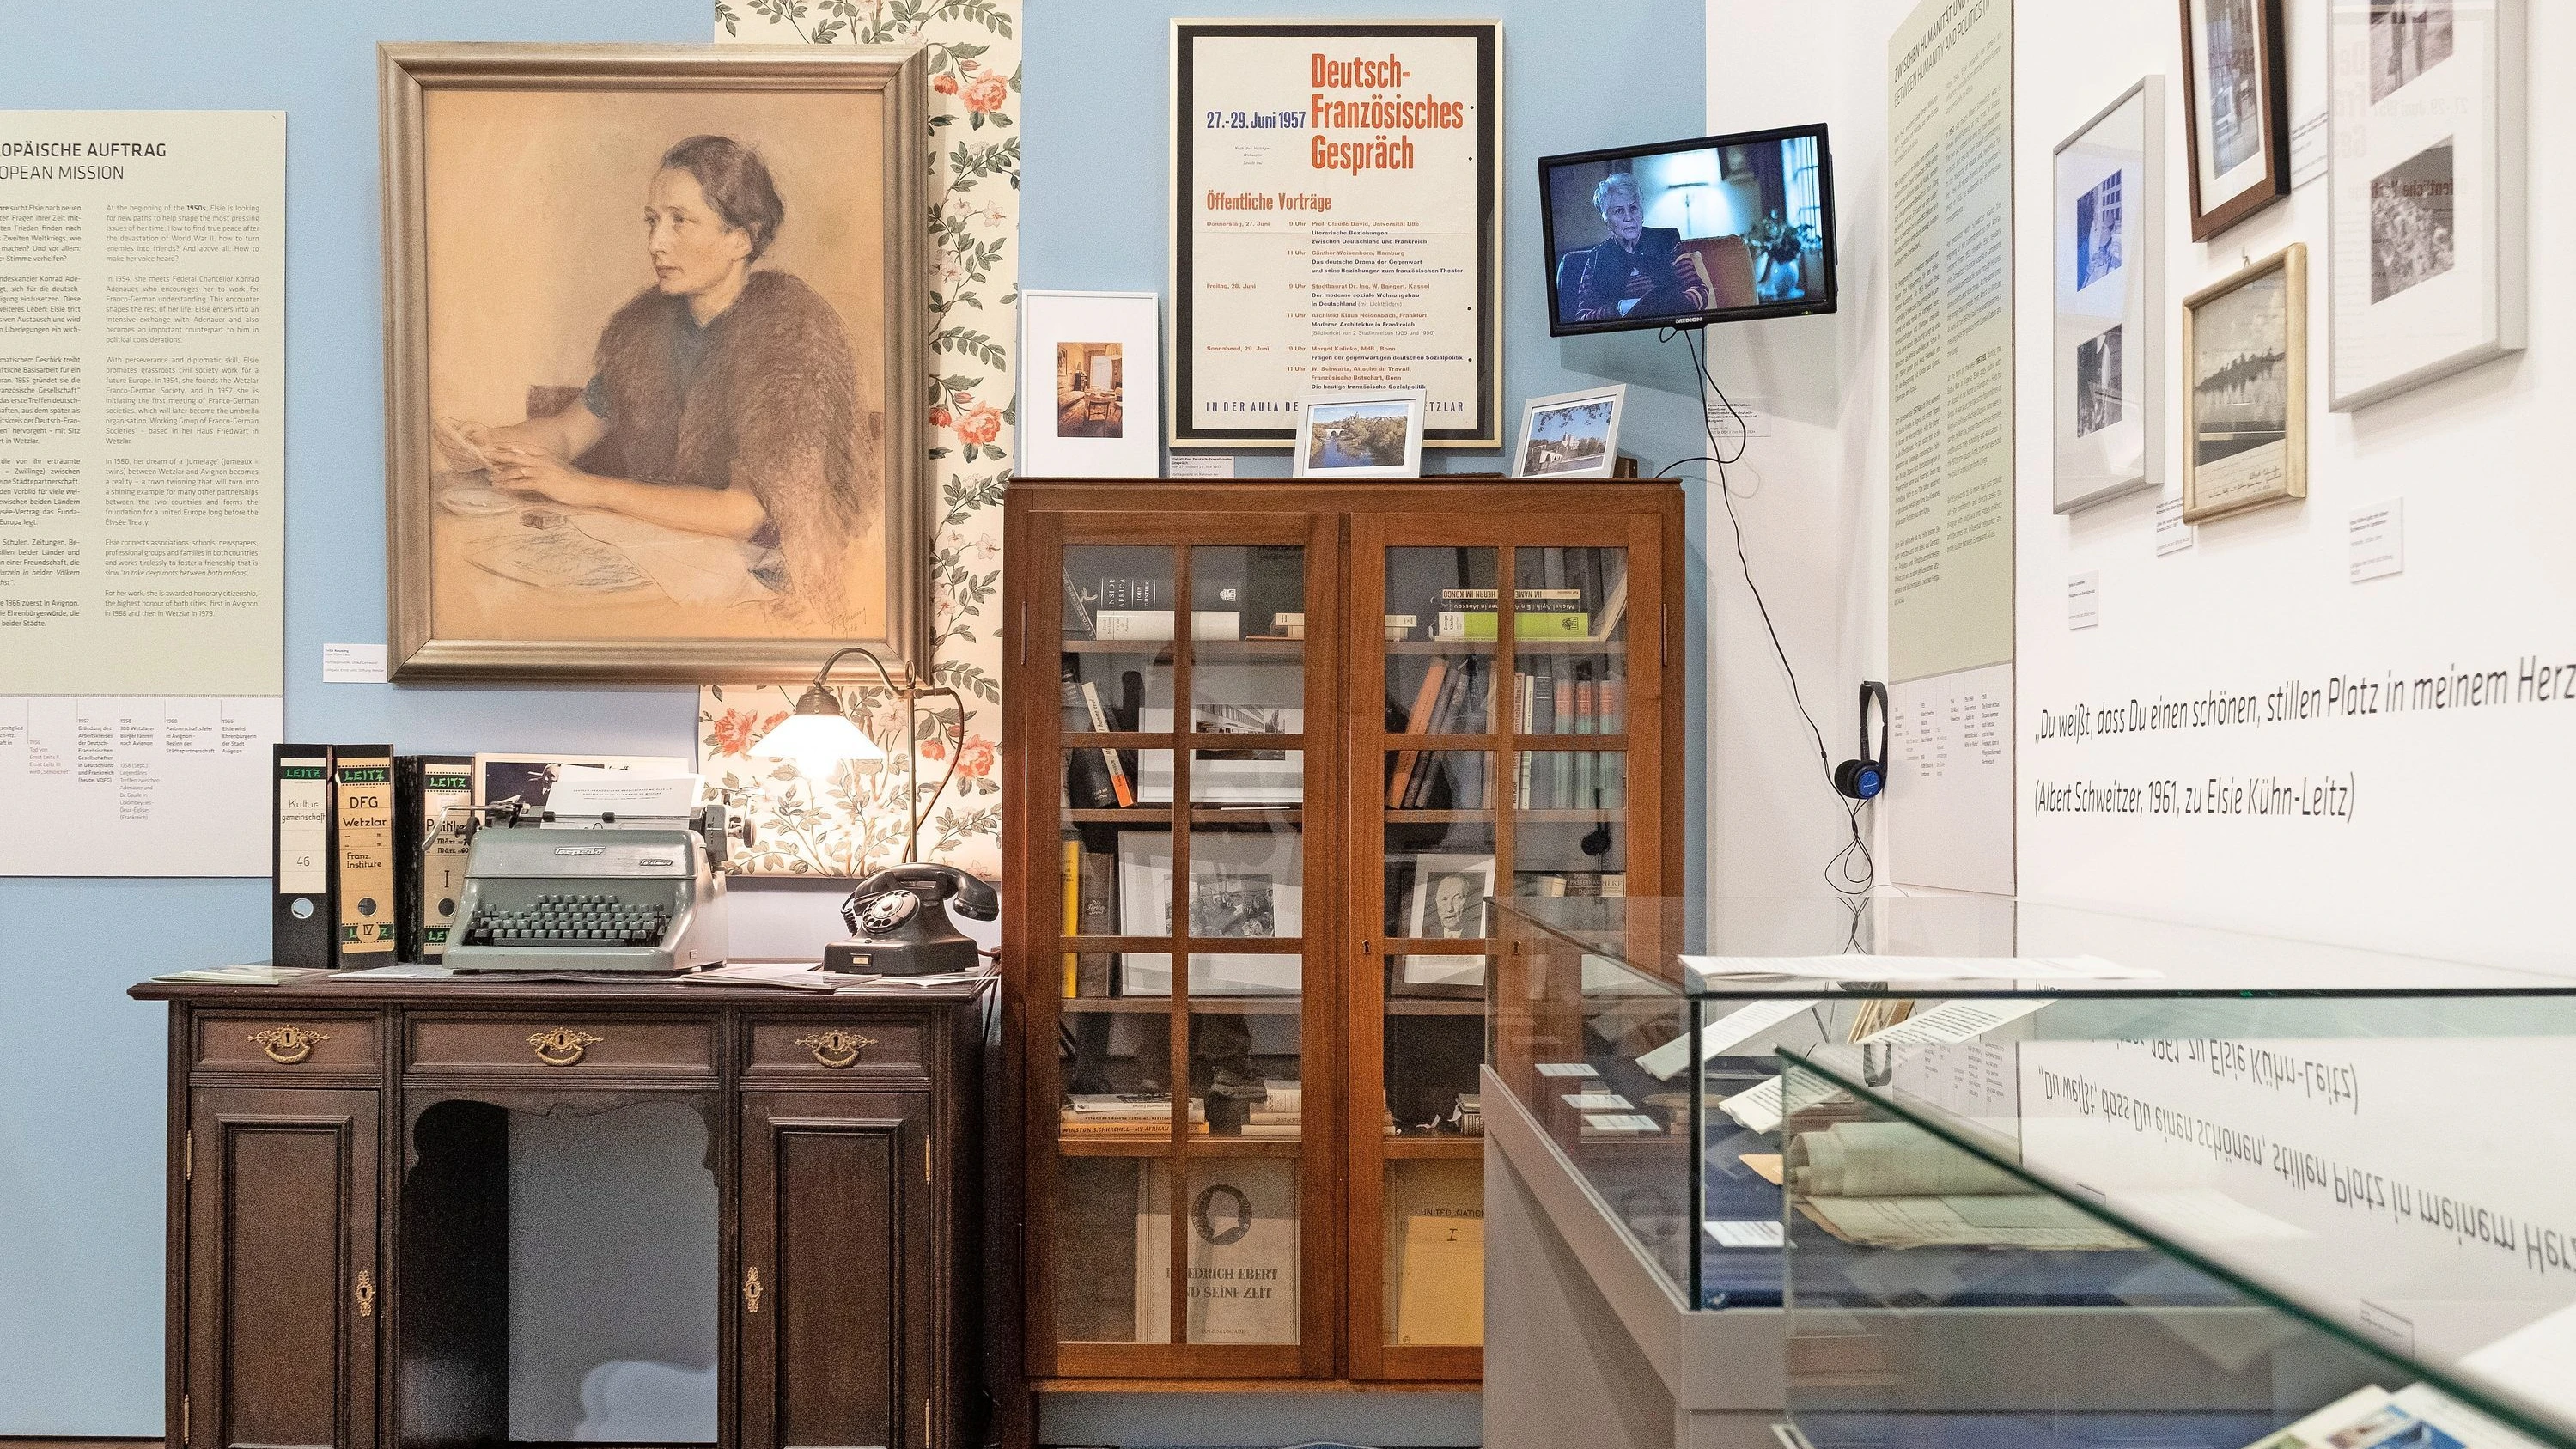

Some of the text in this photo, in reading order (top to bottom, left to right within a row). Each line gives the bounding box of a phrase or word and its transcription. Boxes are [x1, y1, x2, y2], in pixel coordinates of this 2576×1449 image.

[1312, 53, 1410, 88] Deutsch-
[1312, 94, 1463, 129] Französisches
[1207, 112, 1306, 128] 27.-29. Juni 1957
[0, 141, 167, 157] OPÄISCHE AUFTRAG
[1312, 135, 1413, 176] Gespräch
[59, 166, 123, 180] MISSION
[1207, 190, 1331, 212] Öffentliche Vorträge
[1207, 402, 1464, 412] IN DER AULA DE TZLAR
[2058, 703, 2093, 744] weißt,
[2096, 701, 2125, 735] dass
[2129, 699, 2147, 733] Du
[2150, 695, 2189, 730] einen
[2192, 689, 2262, 728] schönen,
[2267, 680, 2322, 722] stillen
[2329, 674, 2378, 718] Platz
[2384, 670, 2405, 713] in
[2412, 663, 2508, 711] meinem
[286, 768, 320, 778] LEITZ
[344, 769, 385, 782] LEITZ
[430, 777, 466, 787] LEITZ
[289, 799, 319, 808] Kultur-
[350, 796, 378, 808] DFG
[2034, 771, 2355, 824] (Albert Schweitzer, 1961, zu Elsie Kühn-Leitz)
[282, 813, 326, 823] gemeinschaft
[343, 818, 387, 827] Wetzlar
[297, 856, 310, 867] 46
[1237, 1268, 1278, 1280] EBERT
[1203, 1285, 1240, 1299] SEINE
[1243, 1286, 1272, 1299] ZEIT
